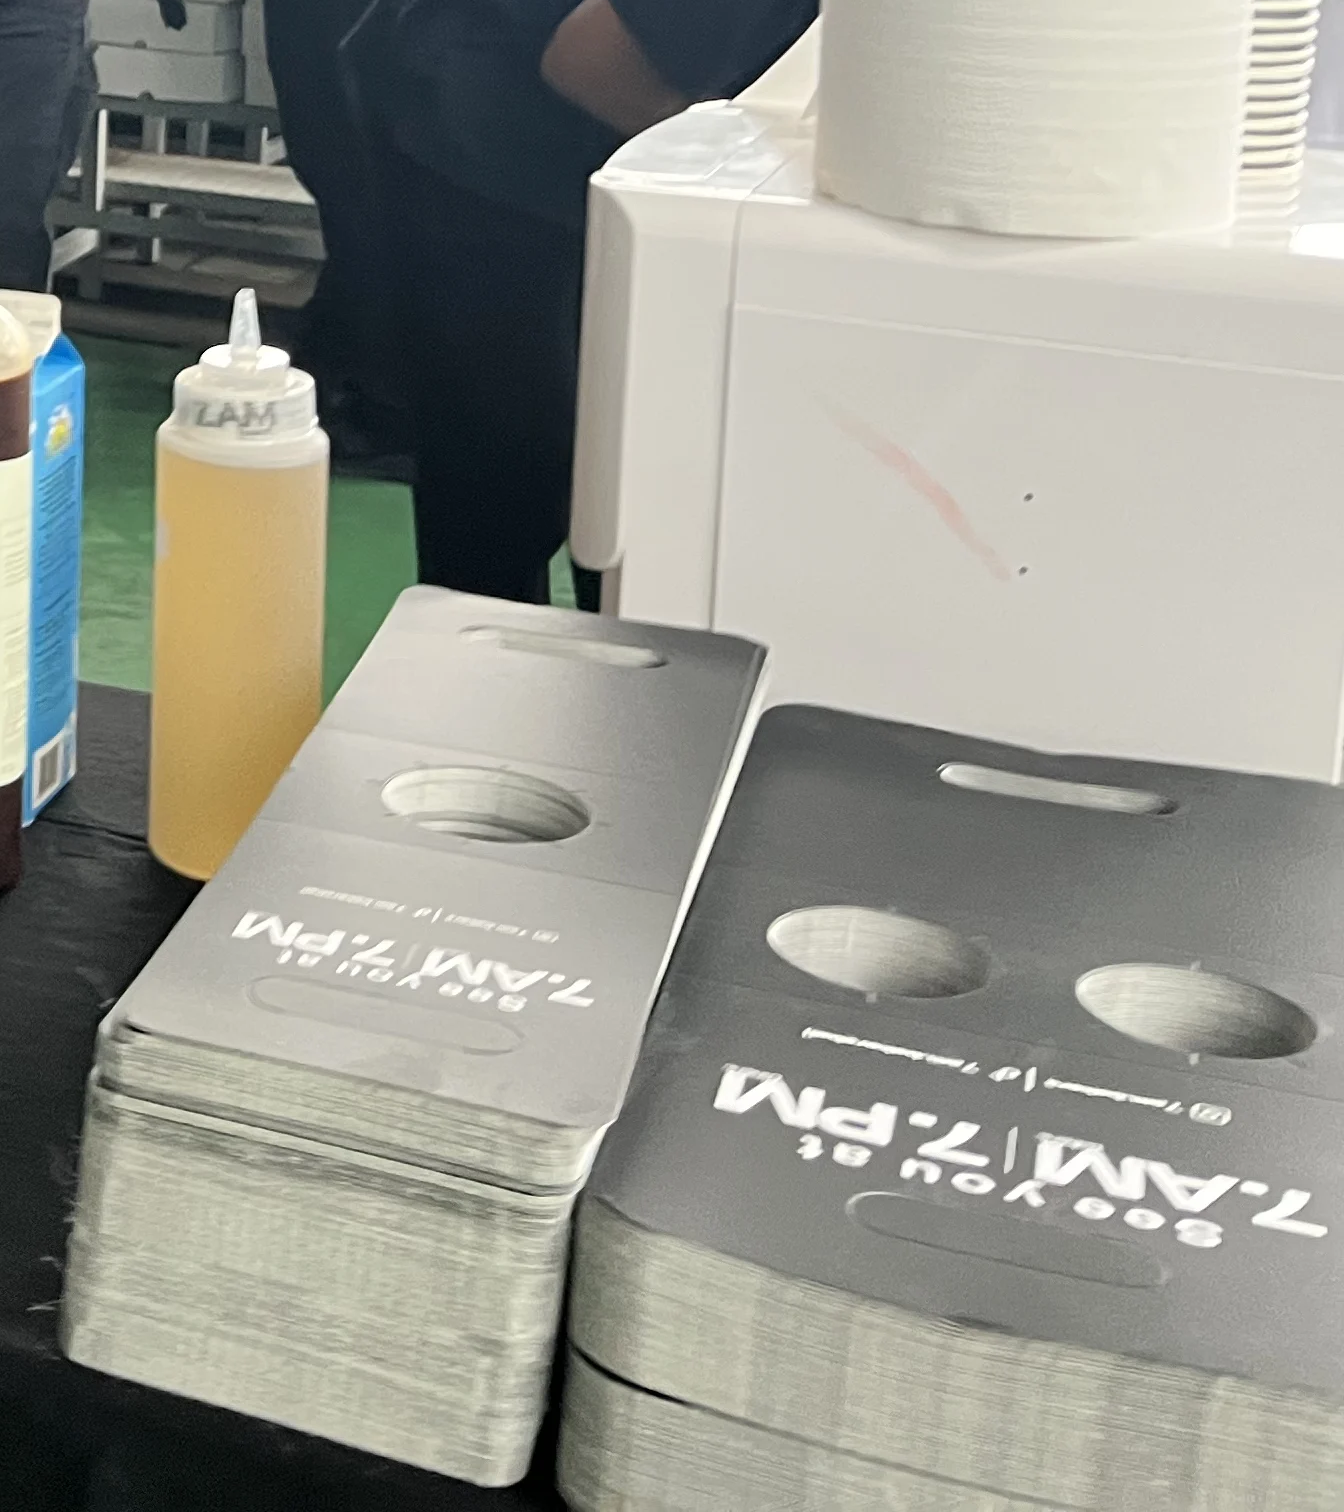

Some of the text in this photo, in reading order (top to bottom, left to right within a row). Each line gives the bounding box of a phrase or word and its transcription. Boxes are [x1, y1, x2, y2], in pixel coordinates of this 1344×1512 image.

[232, 909, 396, 968] 7.PM
[419, 947, 595, 1008] 7.AM
[713, 1062, 990, 1168] 7.PM
[796, 1133, 873, 1168] at
[899, 1158, 1045, 1208] you
[1034, 1131, 1328, 1238] 7.AM
